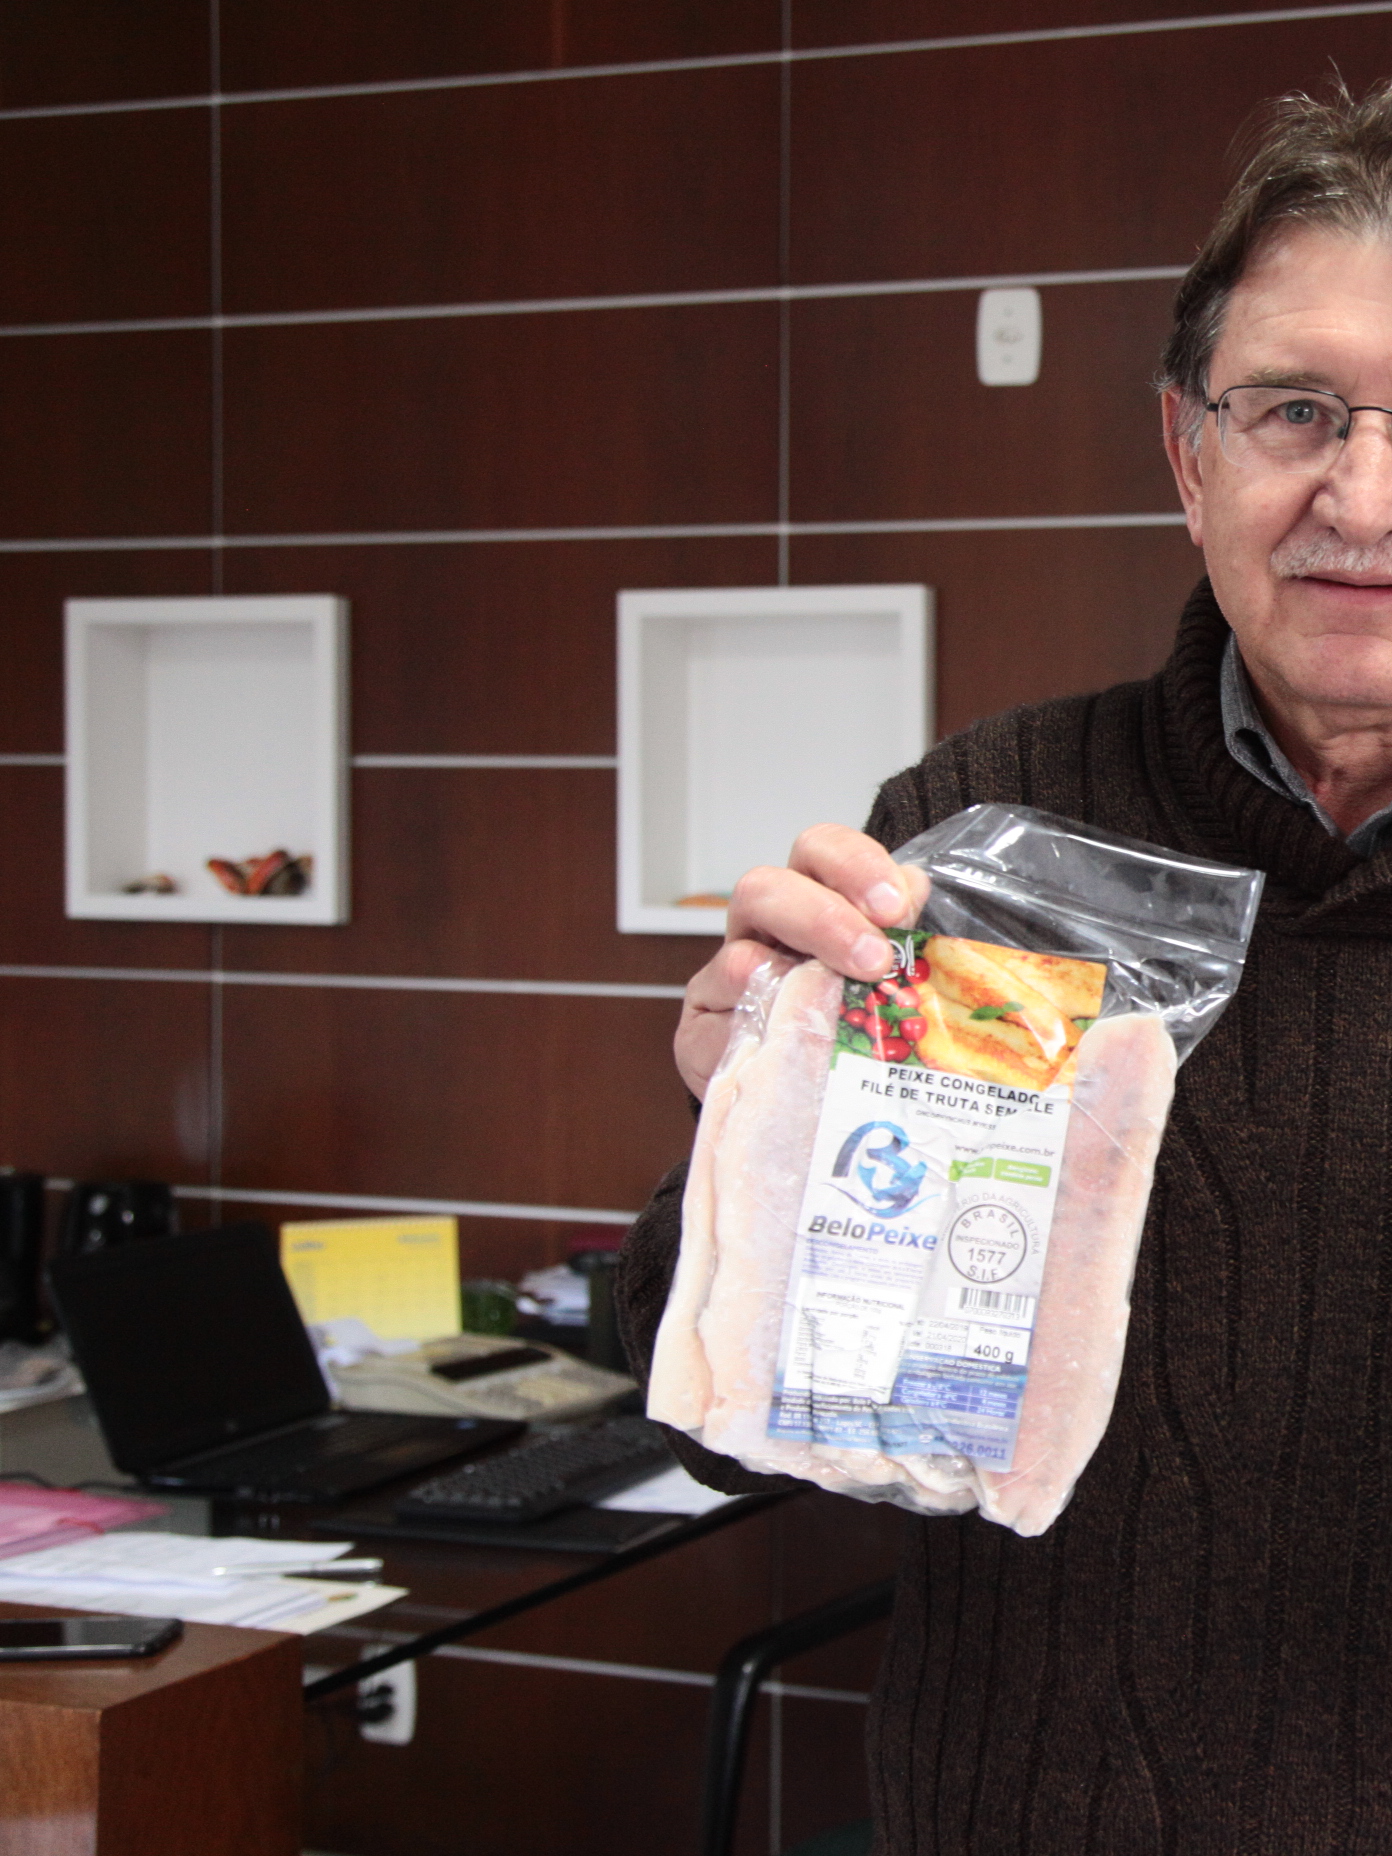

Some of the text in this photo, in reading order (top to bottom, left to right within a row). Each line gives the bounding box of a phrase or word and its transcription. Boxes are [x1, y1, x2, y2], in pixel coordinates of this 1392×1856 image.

[888, 1067, 934, 1085] PEIXE
[861, 1080, 894, 1097] FILÉ
[900, 1087, 919, 1100] DE
[926, 1091, 979, 1112] TRUTA
[808, 1215, 938, 1251] BeloPeixe
[961, 1209, 1019, 1239] BRASIL
[968, 1247, 1006, 1265] 1577
[973, 1344, 1014, 1364] 400 g
